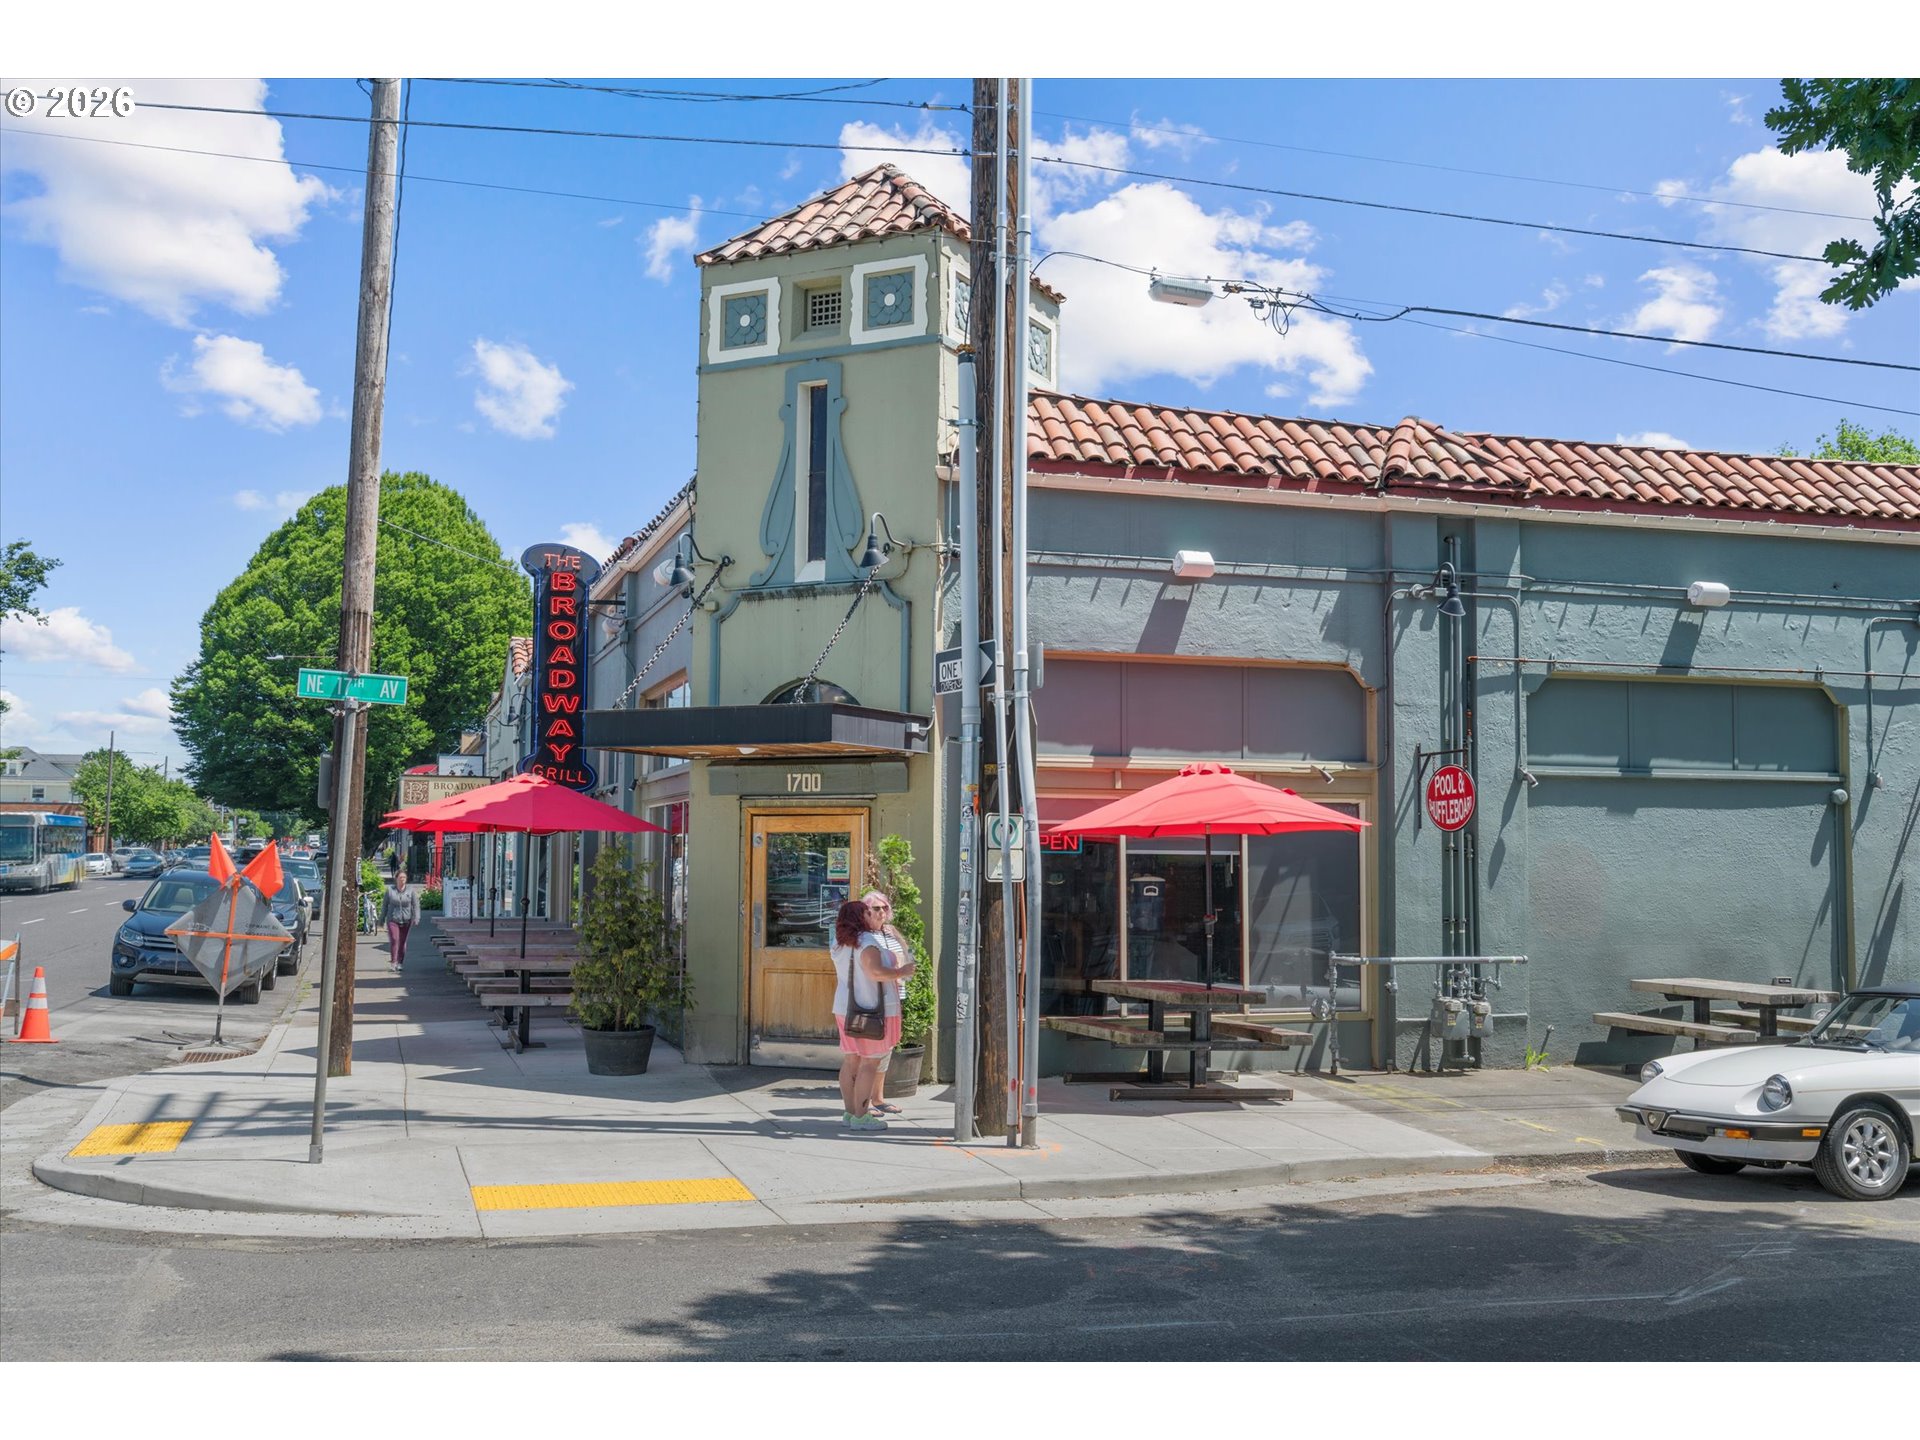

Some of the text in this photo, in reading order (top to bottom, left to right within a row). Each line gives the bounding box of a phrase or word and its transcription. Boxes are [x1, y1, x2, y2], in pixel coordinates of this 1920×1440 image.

[544, 553, 581, 570] THE
[542, 571, 581, 763] BROADWAY
[941, 661, 958, 680] ONE
[306, 674, 399, 699] NE 17TH AV
[532, 764, 587, 785] GRILL
[787, 773, 822, 792] 1700
[1434, 771, 1465, 797] POOL &
[1040, 834, 1078, 850] PEN
